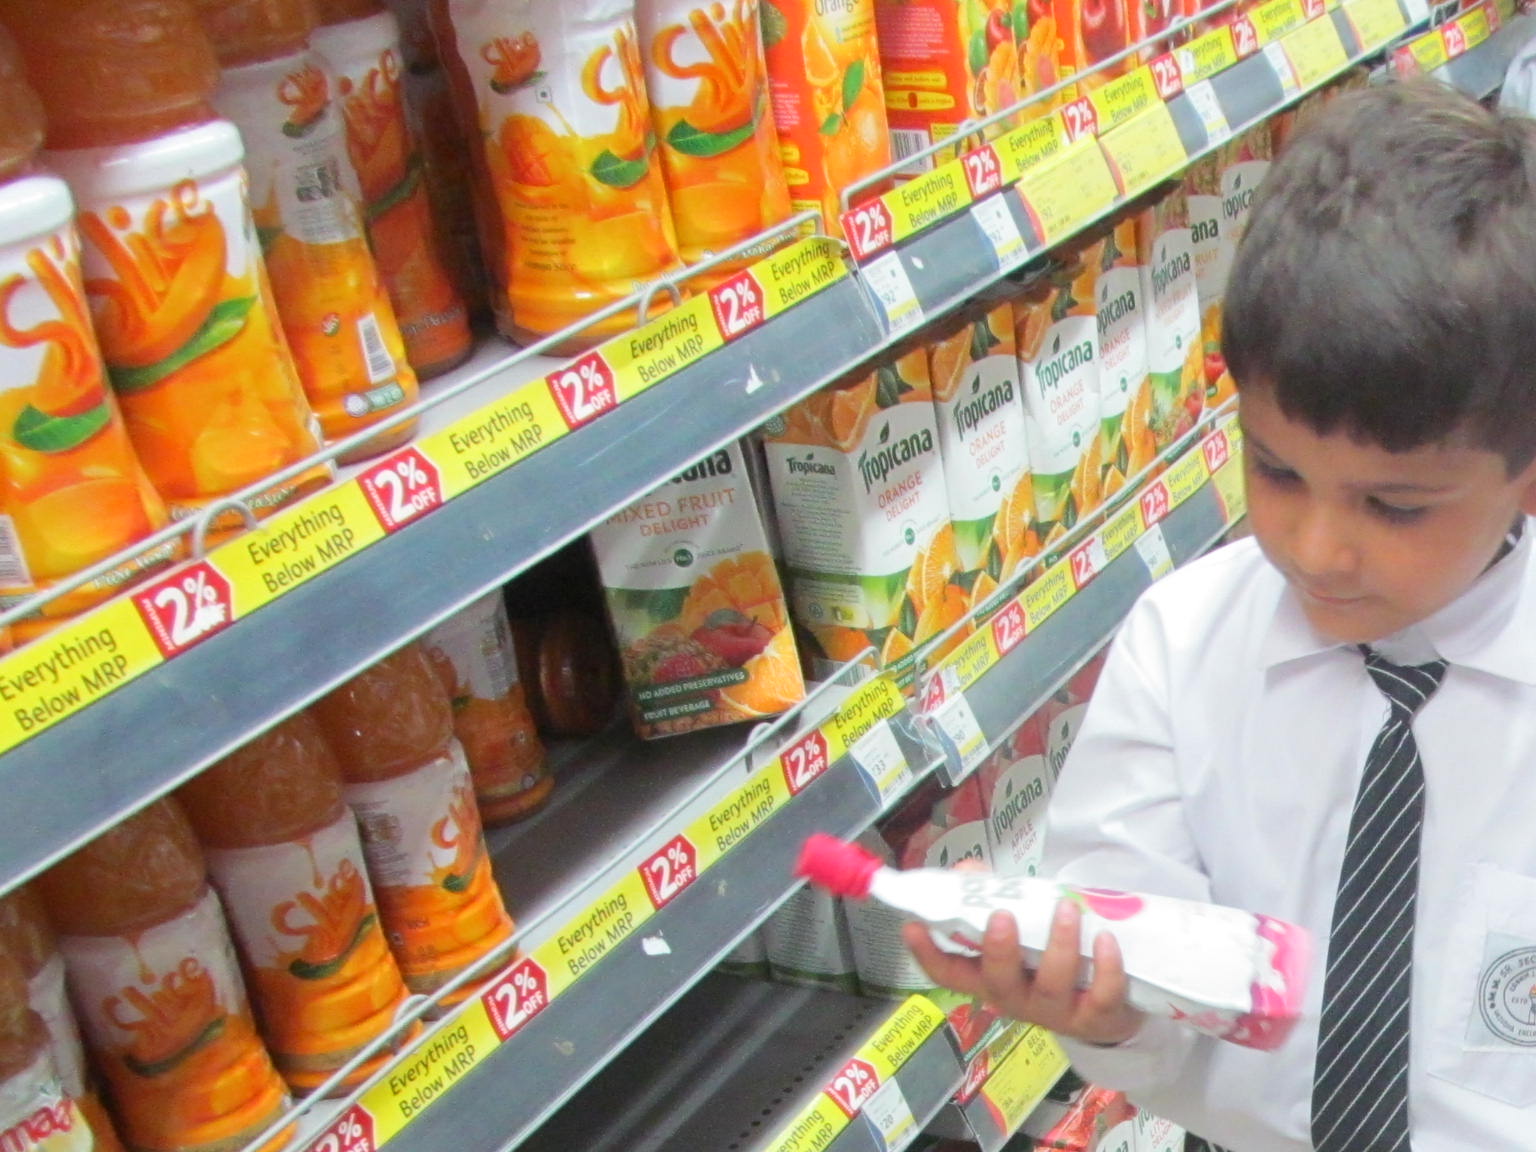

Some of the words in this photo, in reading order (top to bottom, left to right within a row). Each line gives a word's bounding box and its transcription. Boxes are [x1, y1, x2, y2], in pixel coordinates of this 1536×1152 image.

[1009, 119, 1054, 153] Everything
[901, 172, 954, 207] Everything
[969, 149, 995, 194] 2%
[856, 202, 886, 254] 2%
[909, 204, 938, 229] Below
[938, 193, 958, 218] MRP
[771, 240, 830, 283] Everything
[779, 274, 810, 305] Below
[811, 262, 835, 288] MRP
[719, 277, 757, 331] 2%
[743, 305, 762, 325] OFF
[629, 313, 698, 360] Everything
[637, 349, 673, 384] Below
[674, 334, 704, 366] MRP
[560, 360, 604, 420] 2%
[589, 387, 613, 411] OFF
[1035, 340, 1093, 400] Tropicana
[952, 379, 1014, 442] Tropicana
[1050, 379, 1085, 413] ORANGE
[1055, 398, 1085, 428] DELIGHT
[448, 402, 533, 455] Everything
[464, 437, 509, 480] Below
[510, 424, 544, 457] MRP
[968, 421, 1007, 456] ORANGE
[786, 456, 836, 476] Tropicana
[858, 428, 934, 494] Tropicana
[975, 441, 1006, 469] DELIGHT
[374, 456, 427, 524] 2%
[606, 500, 672, 525] MIXED
[679, 488, 736, 513] FRUIT
[878, 470, 923, 508] ORANGE
[886, 493, 921, 522] DELIGHT
[247, 504, 345, 566] Everything
[640, 513, 711, 537] DELIGHT
[261, 551, 316, 593] Below
[316, 528, 355, 564] MRP
[154, 571, 218, 650] 2%
[16, 684, 80, 731] Below
[82, 653, 128, 694] MRP
[639, 689, 652, 701] NO
[653, 684, 681, 700] ADDED
[682, 672, 746, 693] PRESERVATIVES
[643, 708, 667, 720] FRUIT
[669, 700, 711, 717] BEVERAGE
[834, 680, 889, 729] Everything
[873, 698, 895, 723] MRP
[790, 735, 820, 788] 2%
[809, 759, 826, 777] OFF
[708, 777, 771, 831] Everything
[715, 816, 749, 853] Below
[750, 795, 775, 825] MRP
[992, 777, 1044, 845] Tropicana
[1011, 818, 1034, 849] APPLE
[1013, 832, 1038, 864] DELIGHT
[652, 843, 688, 903] 2%
[673, 862, 694, 887] OFF
[558, 892, 628, 954] Everything
[569, 938, 605, 975] Below
[605, 912, 635, 945] MRP
[522, 989, 544, 1016] OFF
[872, 1003, 923, 1053] Everything
[888, 1040, 916, 1068] Below
[915, 1015, 934, 1040] MRP
[389, 1024, 469, 1096] Everything
[399, 1073, 442, 1119] Below
[443, 1046, 478, 1083] MRP
[859, 1077, 877, 1100] OFF
